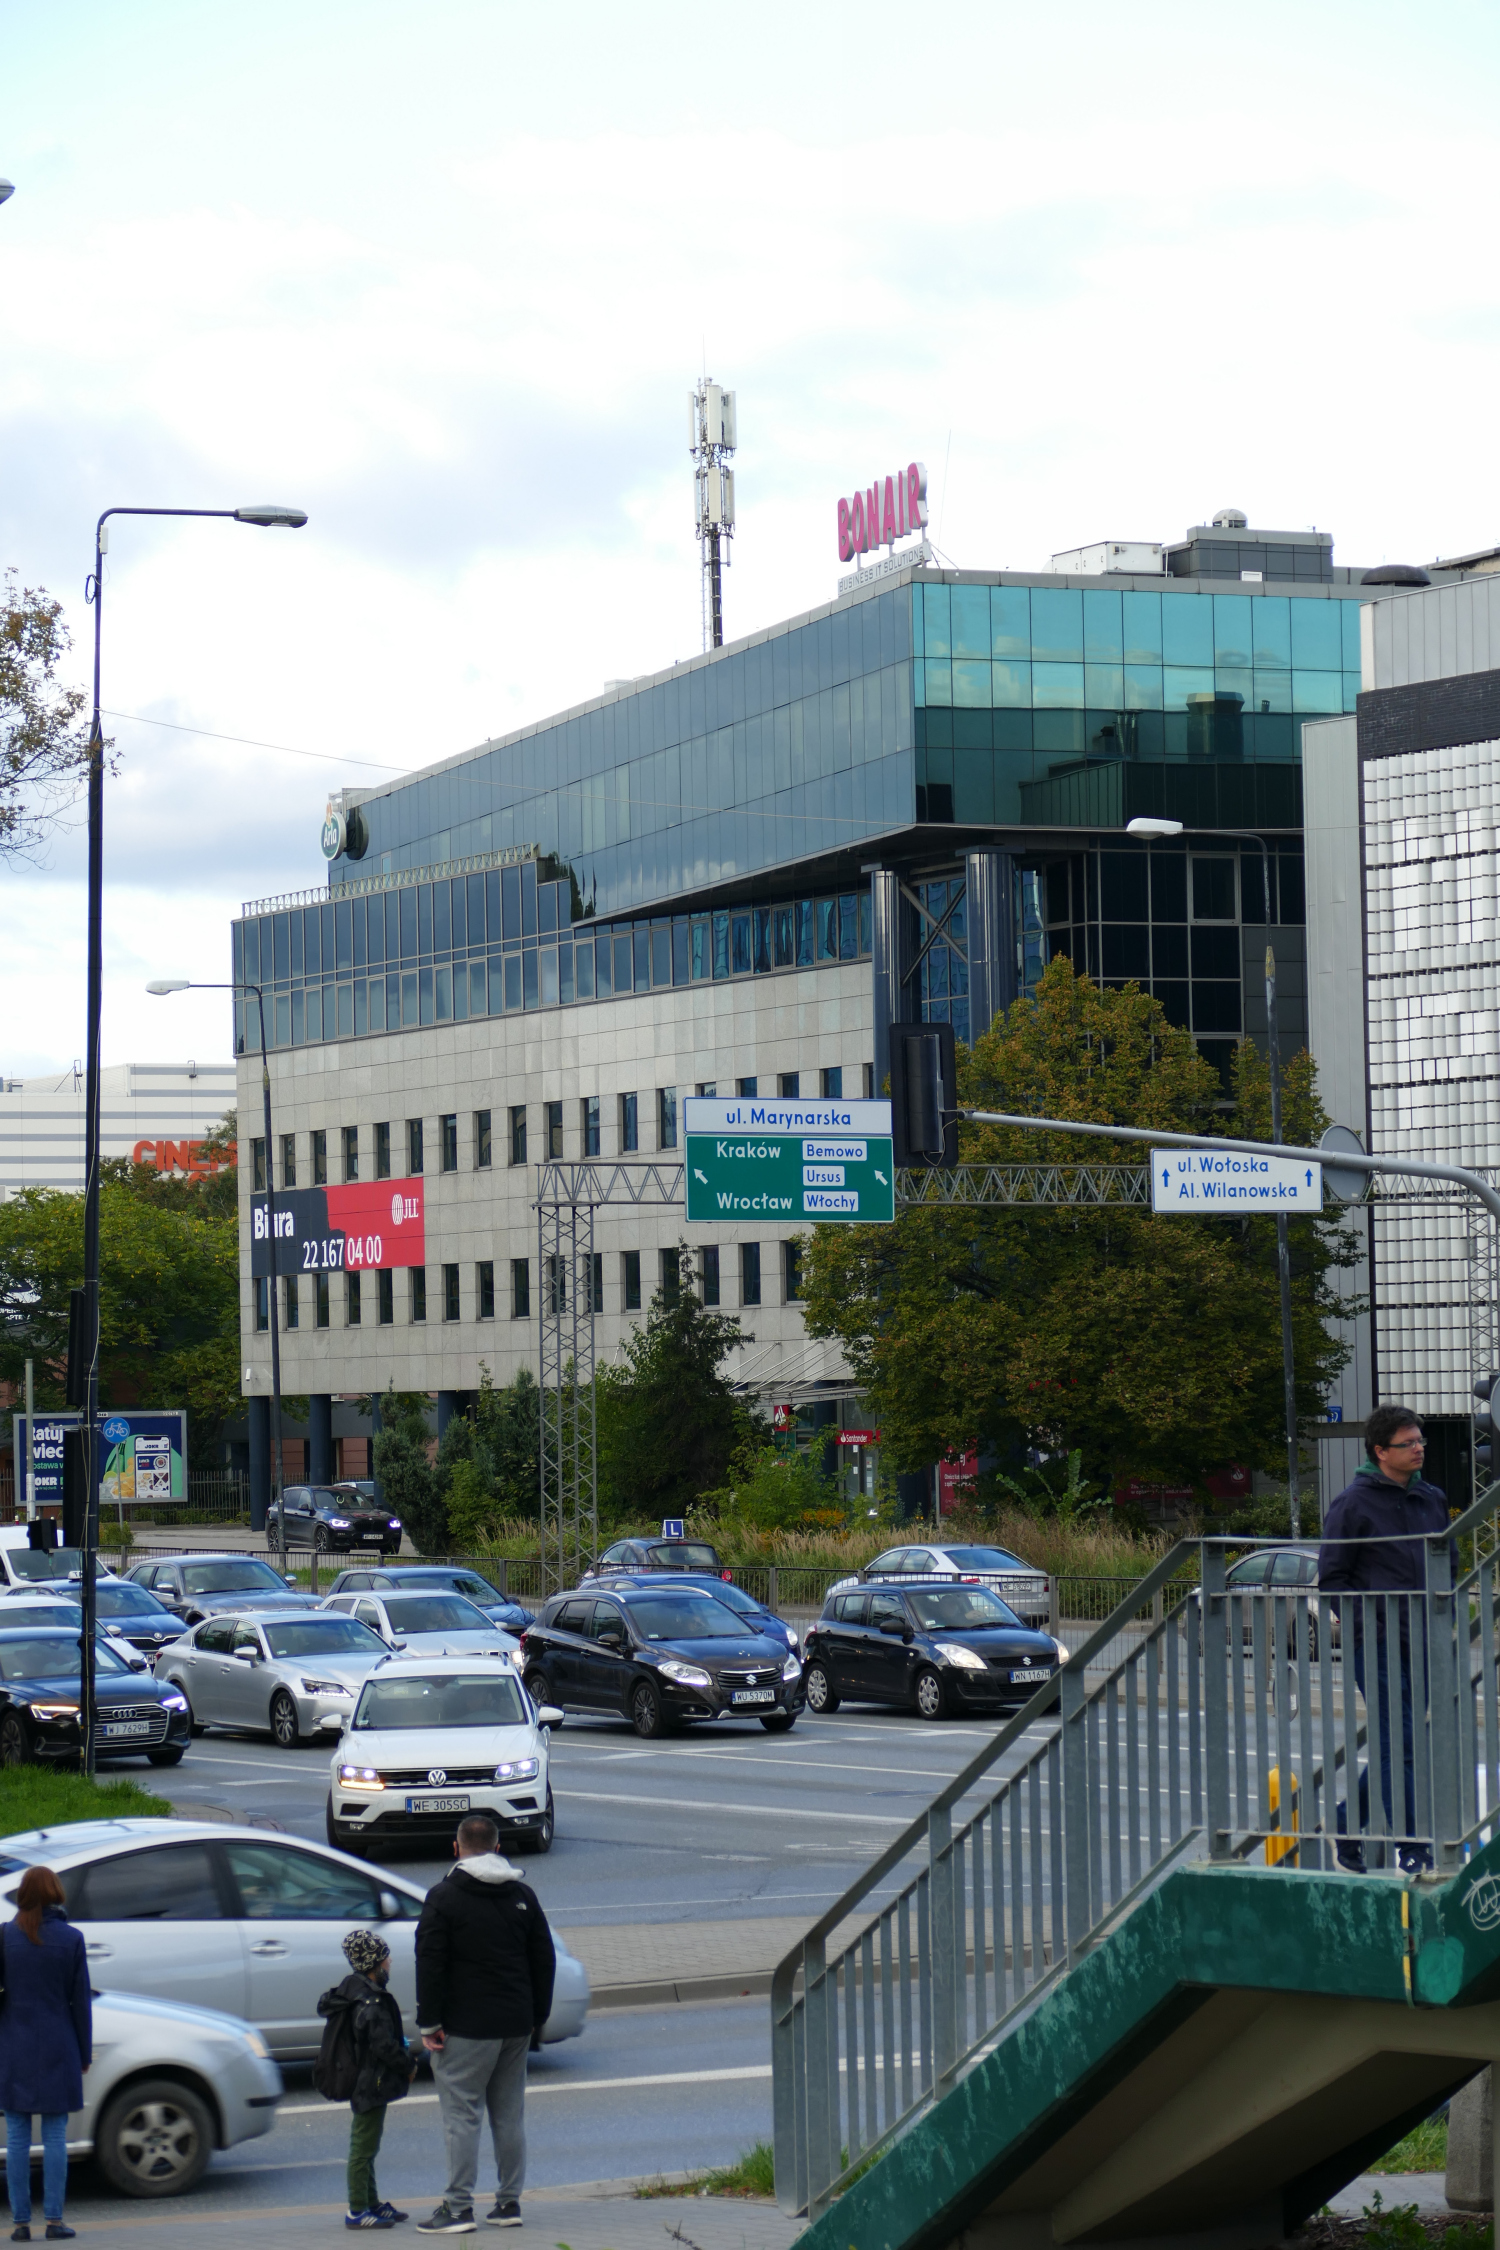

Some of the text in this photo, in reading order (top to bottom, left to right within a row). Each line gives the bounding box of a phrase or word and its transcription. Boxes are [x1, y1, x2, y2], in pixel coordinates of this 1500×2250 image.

[837, 462, 928, 562] BONAIR
[839, 546, 924, 592] BUSINESS IT SOLUTIONS
[324, 826, 337, 847] Arla
[726, 1108, 851, 1130] ul. Marynarska
[717, 1141, 863, 1159] Kraków Bemowo
[1178, 1157, 1269, 1173] ul. Wołoska
[806, 1170, 841, 1183] Ursus
[1179, 1182, 1298, 1199] Al. Wilanowska
[403, 1198, 419, 1219] JLL
[717, 1192, 856, 1211] Wrocław Włochy
[254, 1204, 294, 1239] Biura
[303, 1235, 382, 1269] 22 167 04 00
[846, 1434, 868, 1443] Santander
[33, 1462, 59, 1470] ostawa
[34, 1476, 58, 1486] OKR
[670, 1522, 680, 1536] L
[1015, 1670, 1050, 1681] WN 1167H
[737, 1691, 773, 1701] WU 5370M
[109, 1724, 148, 1734] WJ 7629H
[414, 1799, 467, 1811] WE 305SC
